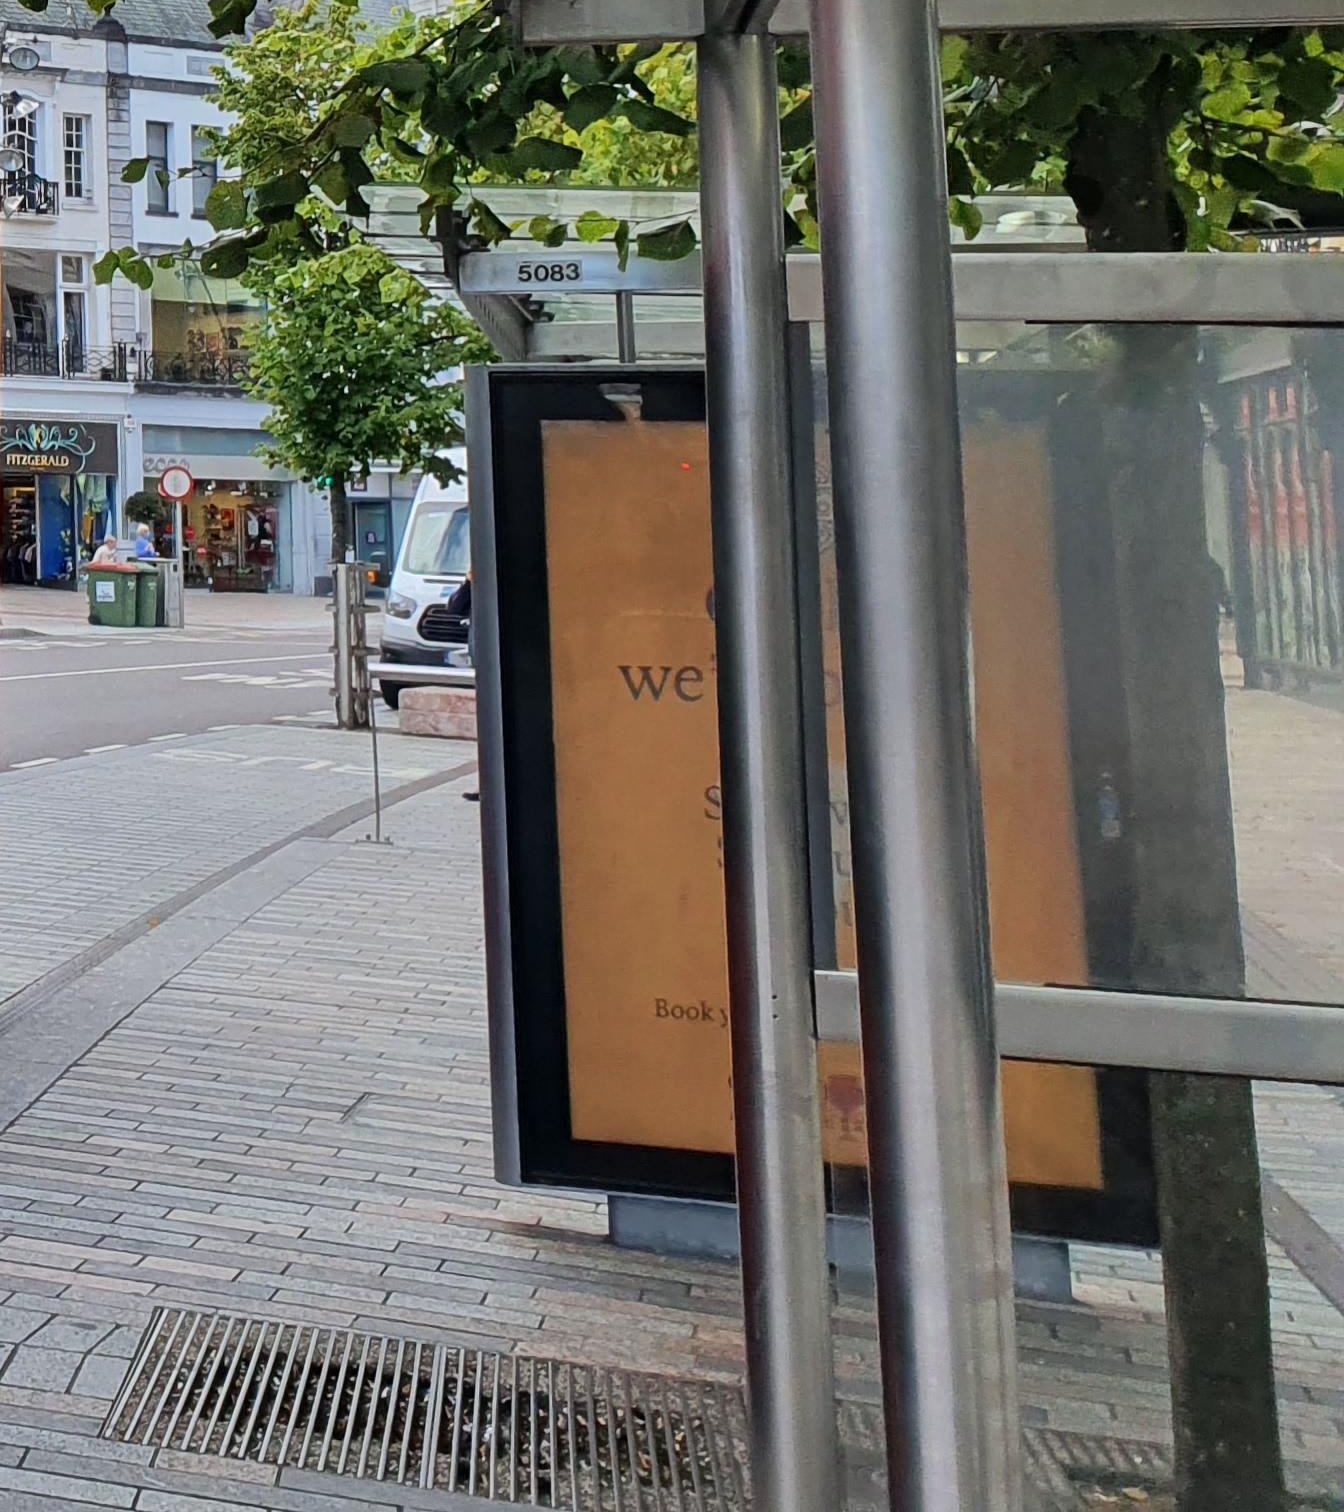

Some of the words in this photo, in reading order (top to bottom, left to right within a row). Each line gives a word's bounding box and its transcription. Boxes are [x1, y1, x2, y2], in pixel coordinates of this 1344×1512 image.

[518, 263, 580, 282] 5083
[6, 454, 69, 467] FITZGERALD
[655, 998, 714, 1021] Book
